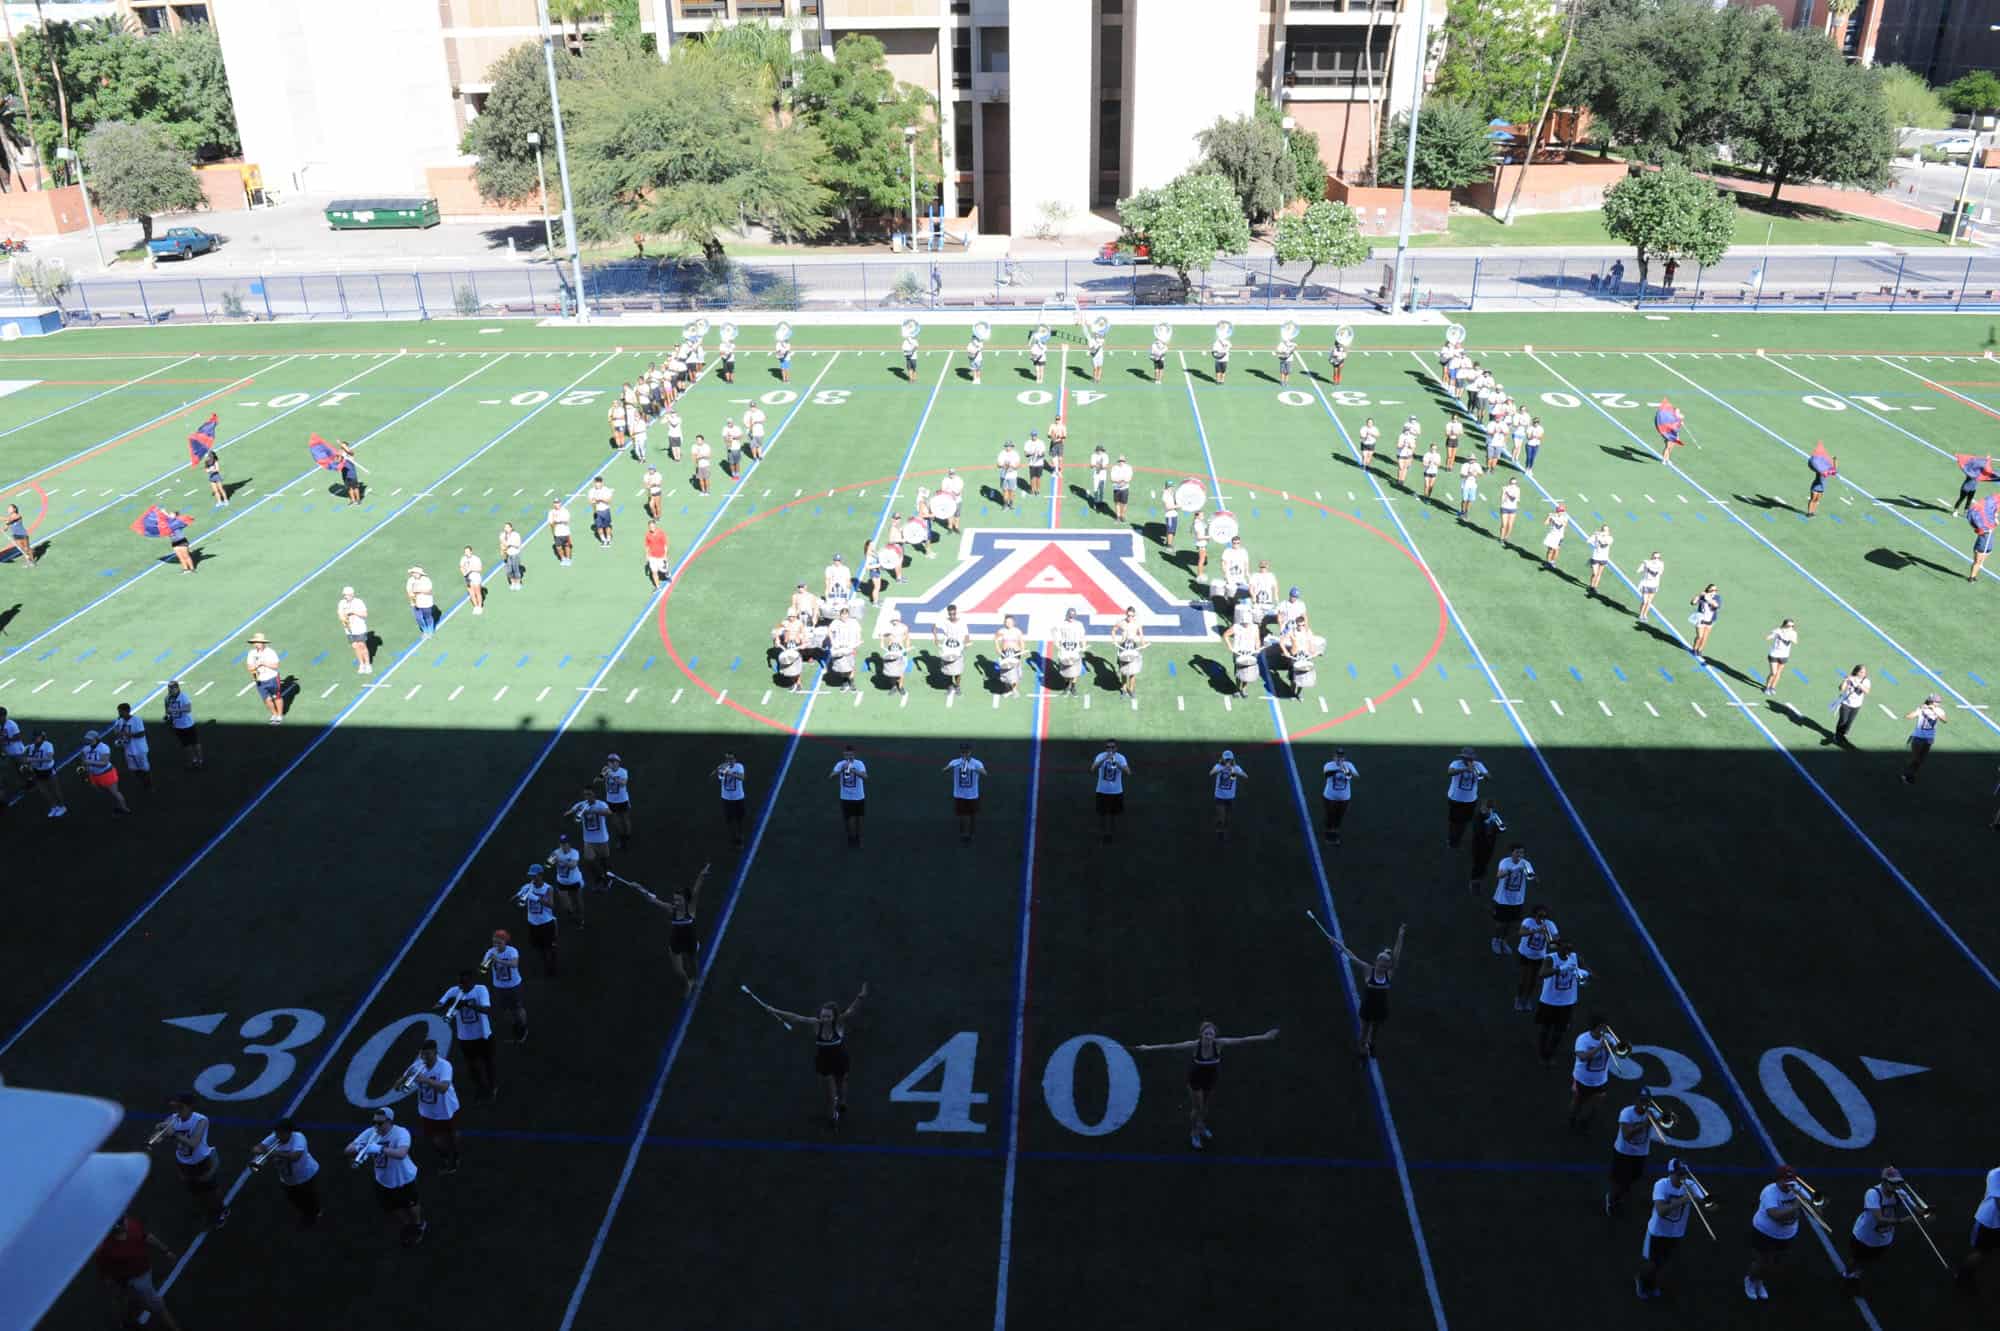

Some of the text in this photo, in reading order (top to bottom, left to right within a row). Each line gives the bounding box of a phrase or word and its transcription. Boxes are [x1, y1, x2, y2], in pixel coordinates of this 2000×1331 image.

[267, 392, 361, 408] 10
[510, 390, 607, 406] 20
[760, 390, 852, 405] 30
[1016, 389, 1108, 405] 40
[1277, 390, 1372, 406] 30
[1540, 392, 1640, 408] 20
[1802, 395, 1902, 411] 10
[873, 527, 1223, 642] A
[192, 1007, 453, 1109] 30
[889, 1031, 1142, 1136] 40
[1607, 1043, 1877, 1150] 30
